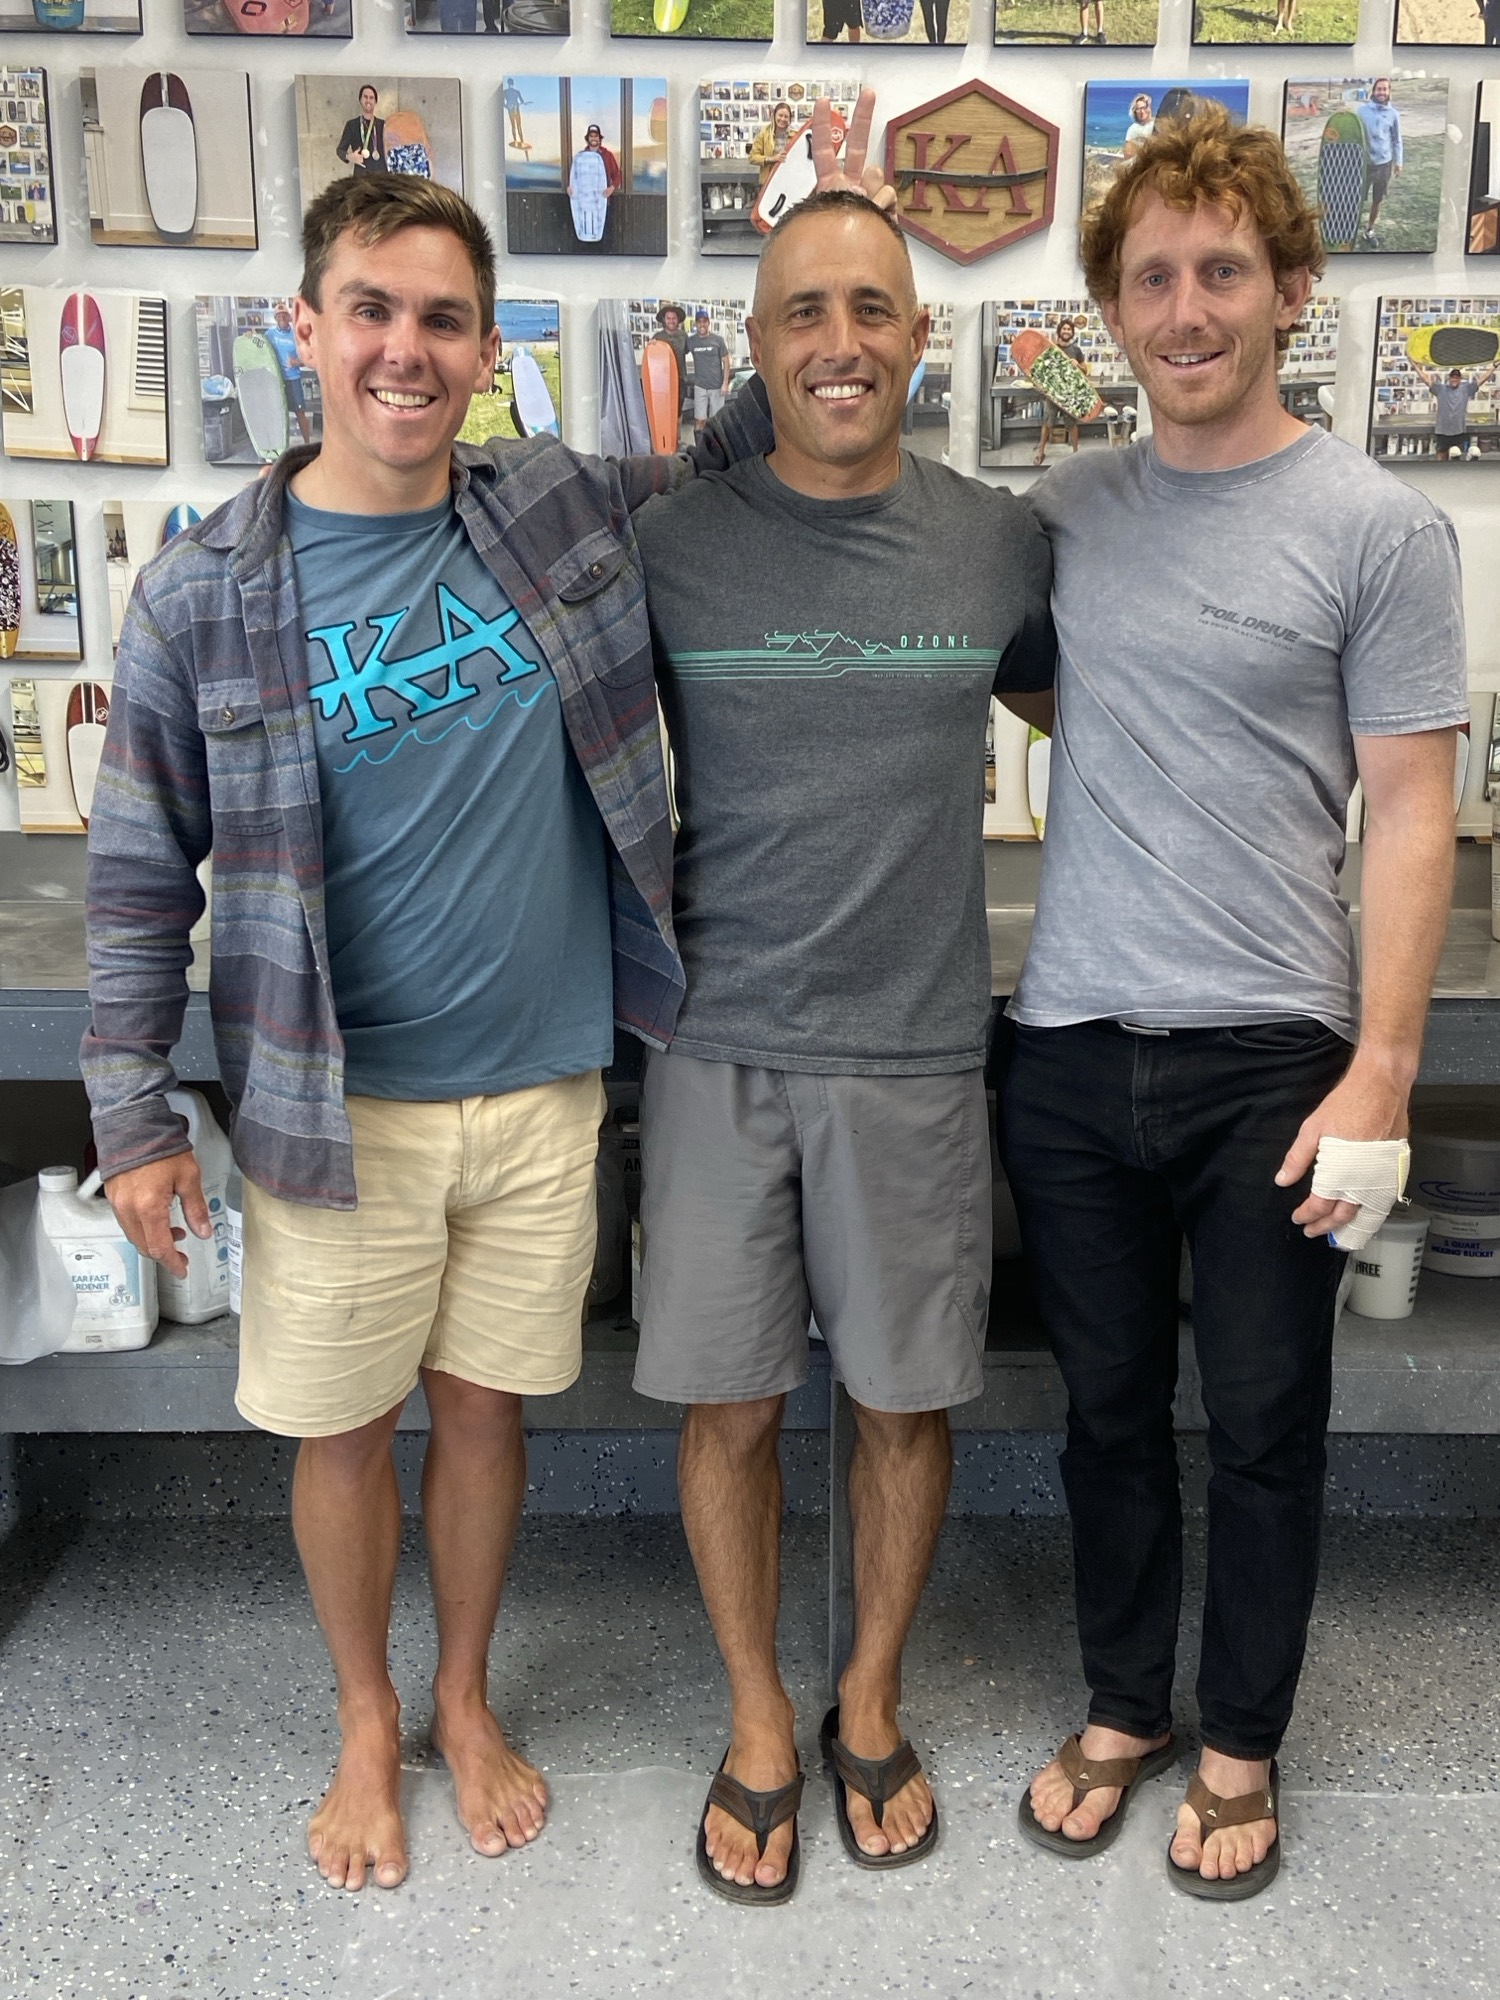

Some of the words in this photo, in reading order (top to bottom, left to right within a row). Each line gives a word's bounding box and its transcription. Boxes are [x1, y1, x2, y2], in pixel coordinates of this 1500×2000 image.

[903, 133, 1032, 215] KA
[1241, 616, 1301, 643] DRIVE
[900, 635, 968, 648] OZONE
[305, 582, 540, 743] KA
[1451, 1241, 1480, 1249] QUART
[1463, 1250, 1495, 1258] BUCKET
[89, 1274, 110, 1282] FAST
